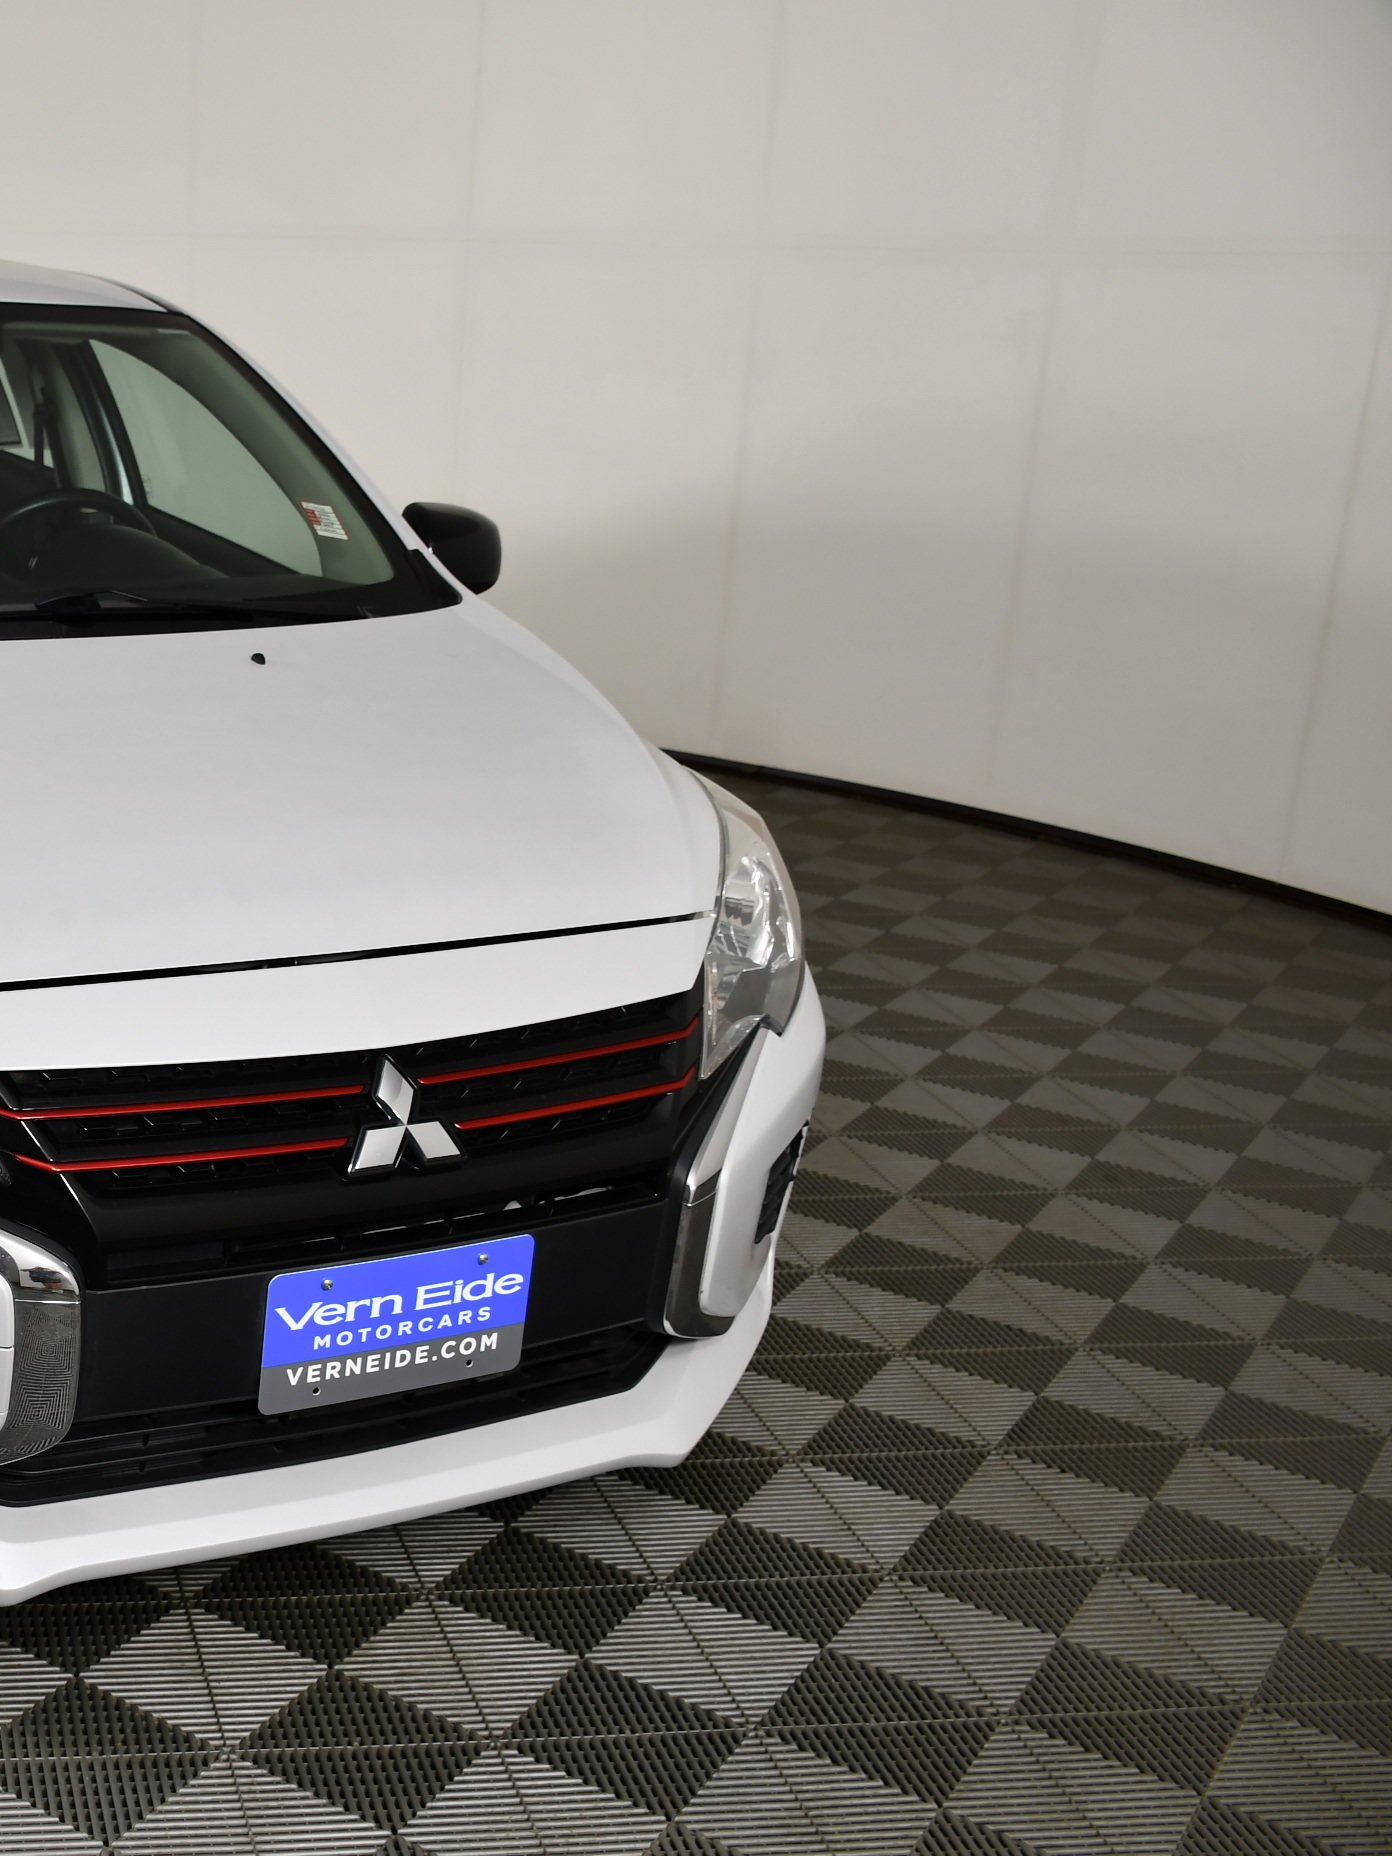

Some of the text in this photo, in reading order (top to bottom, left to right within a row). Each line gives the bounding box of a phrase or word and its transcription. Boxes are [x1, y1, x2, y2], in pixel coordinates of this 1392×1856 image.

[274, 1272, 524, 1331] Vern Eide
[313, 1306, 492, 1350] MOTORCARS
[286, 1332, 499, 1387] VERNEIDE.COM
